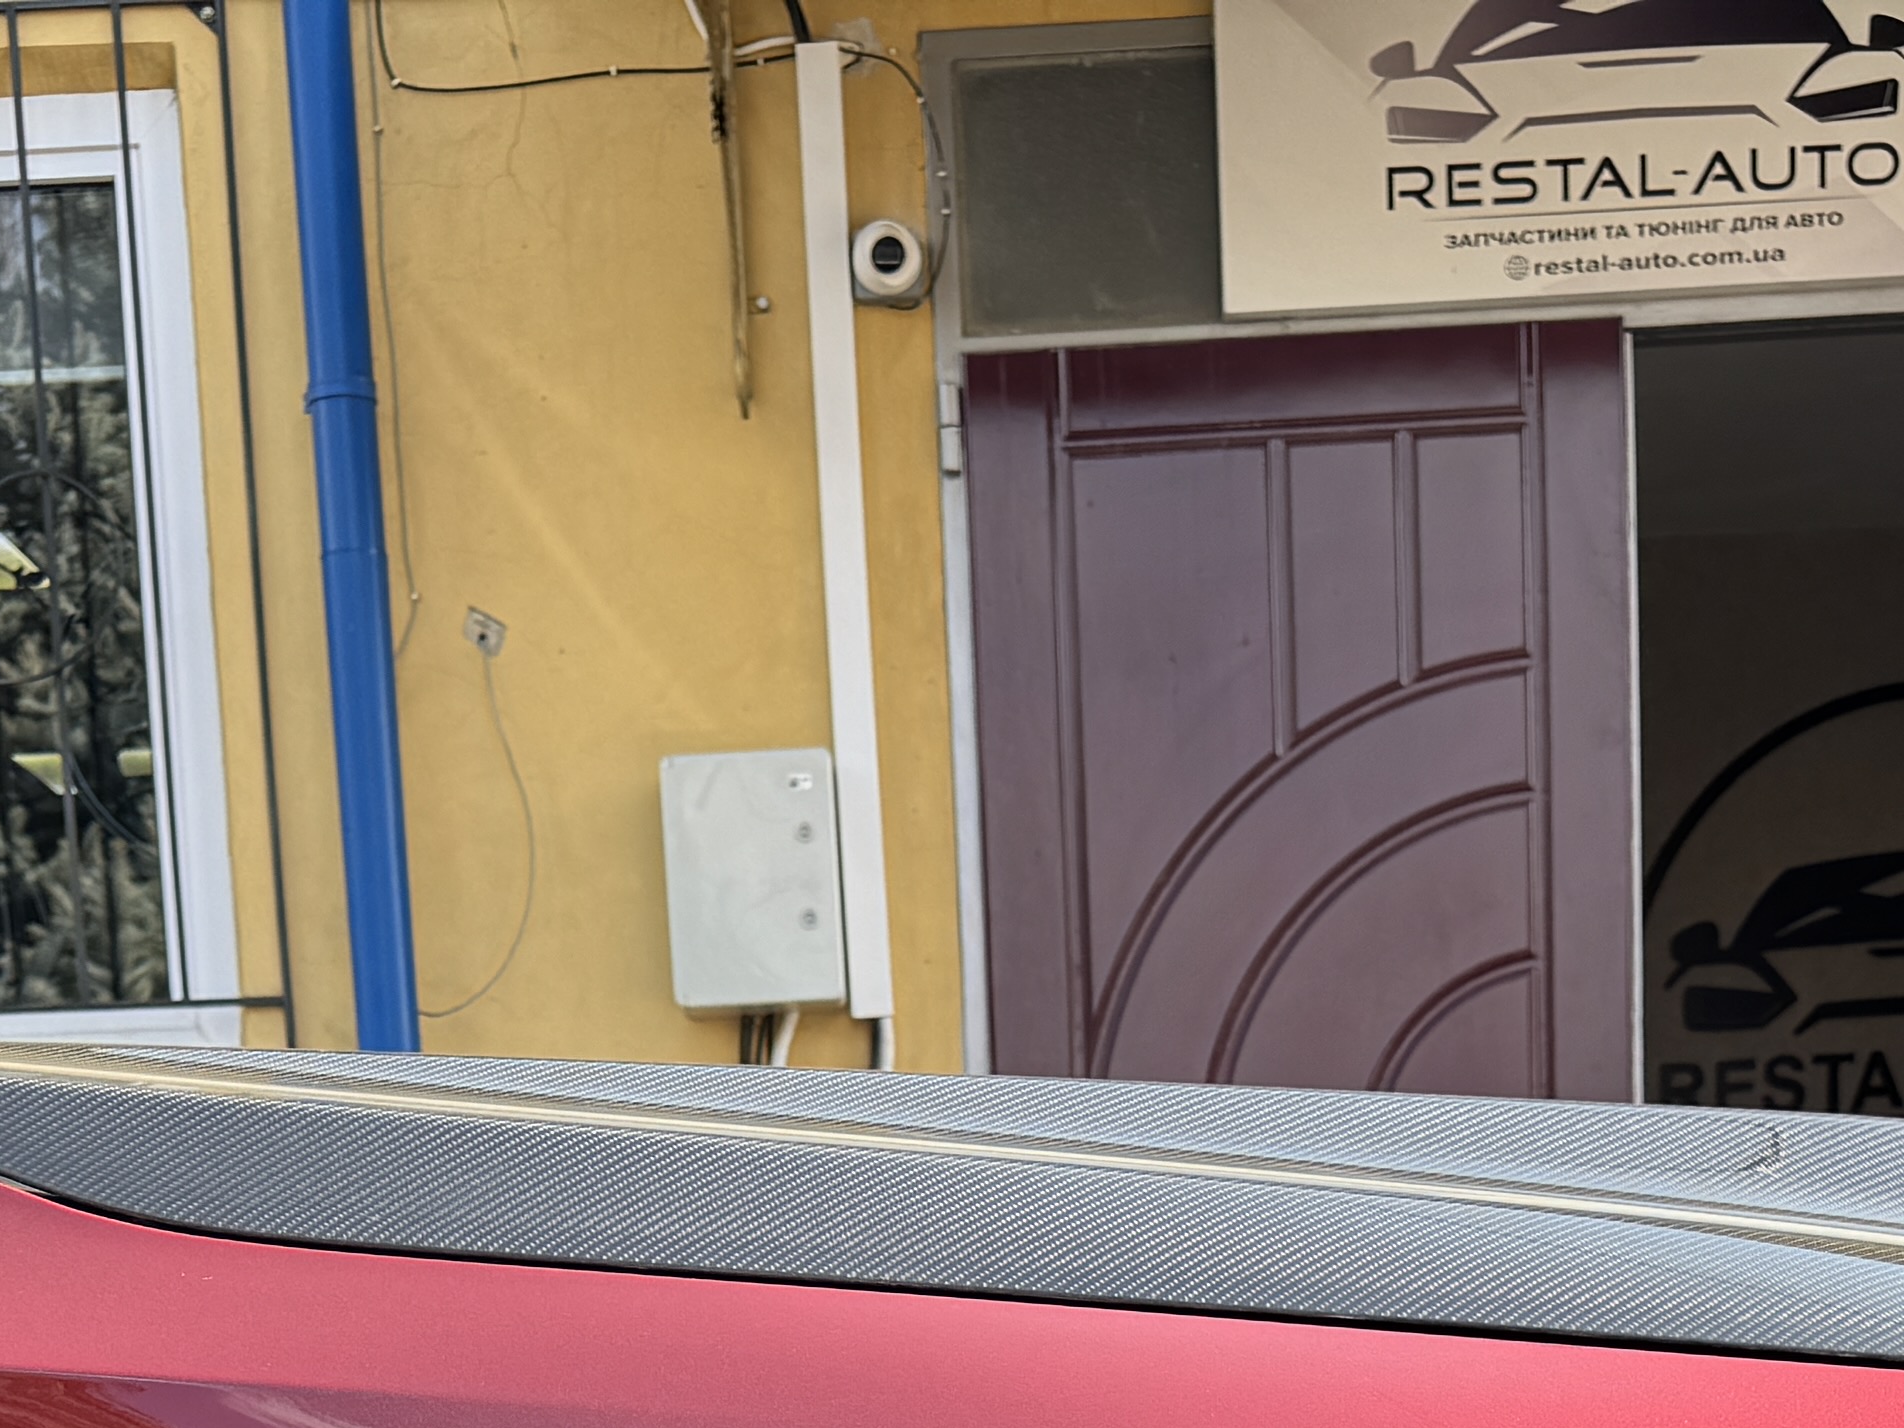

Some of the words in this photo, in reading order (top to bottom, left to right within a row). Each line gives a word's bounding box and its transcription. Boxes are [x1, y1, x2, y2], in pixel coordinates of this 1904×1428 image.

[1386, 142, 1900, 211] RESTAL-AUTO
[1444, 227, 1597, 249] ЗАПЧАСТИНИ
[1604, 225, 1630, 239] ТА
[1635, 219, 1726, 238] ТЮНІНГ
[1729, 215, 1779, 234] ДЛЯ
[1784, 211, 1844, 228] АВТО
[1533, 247, 1787, 277] restal-auto.com.ua
